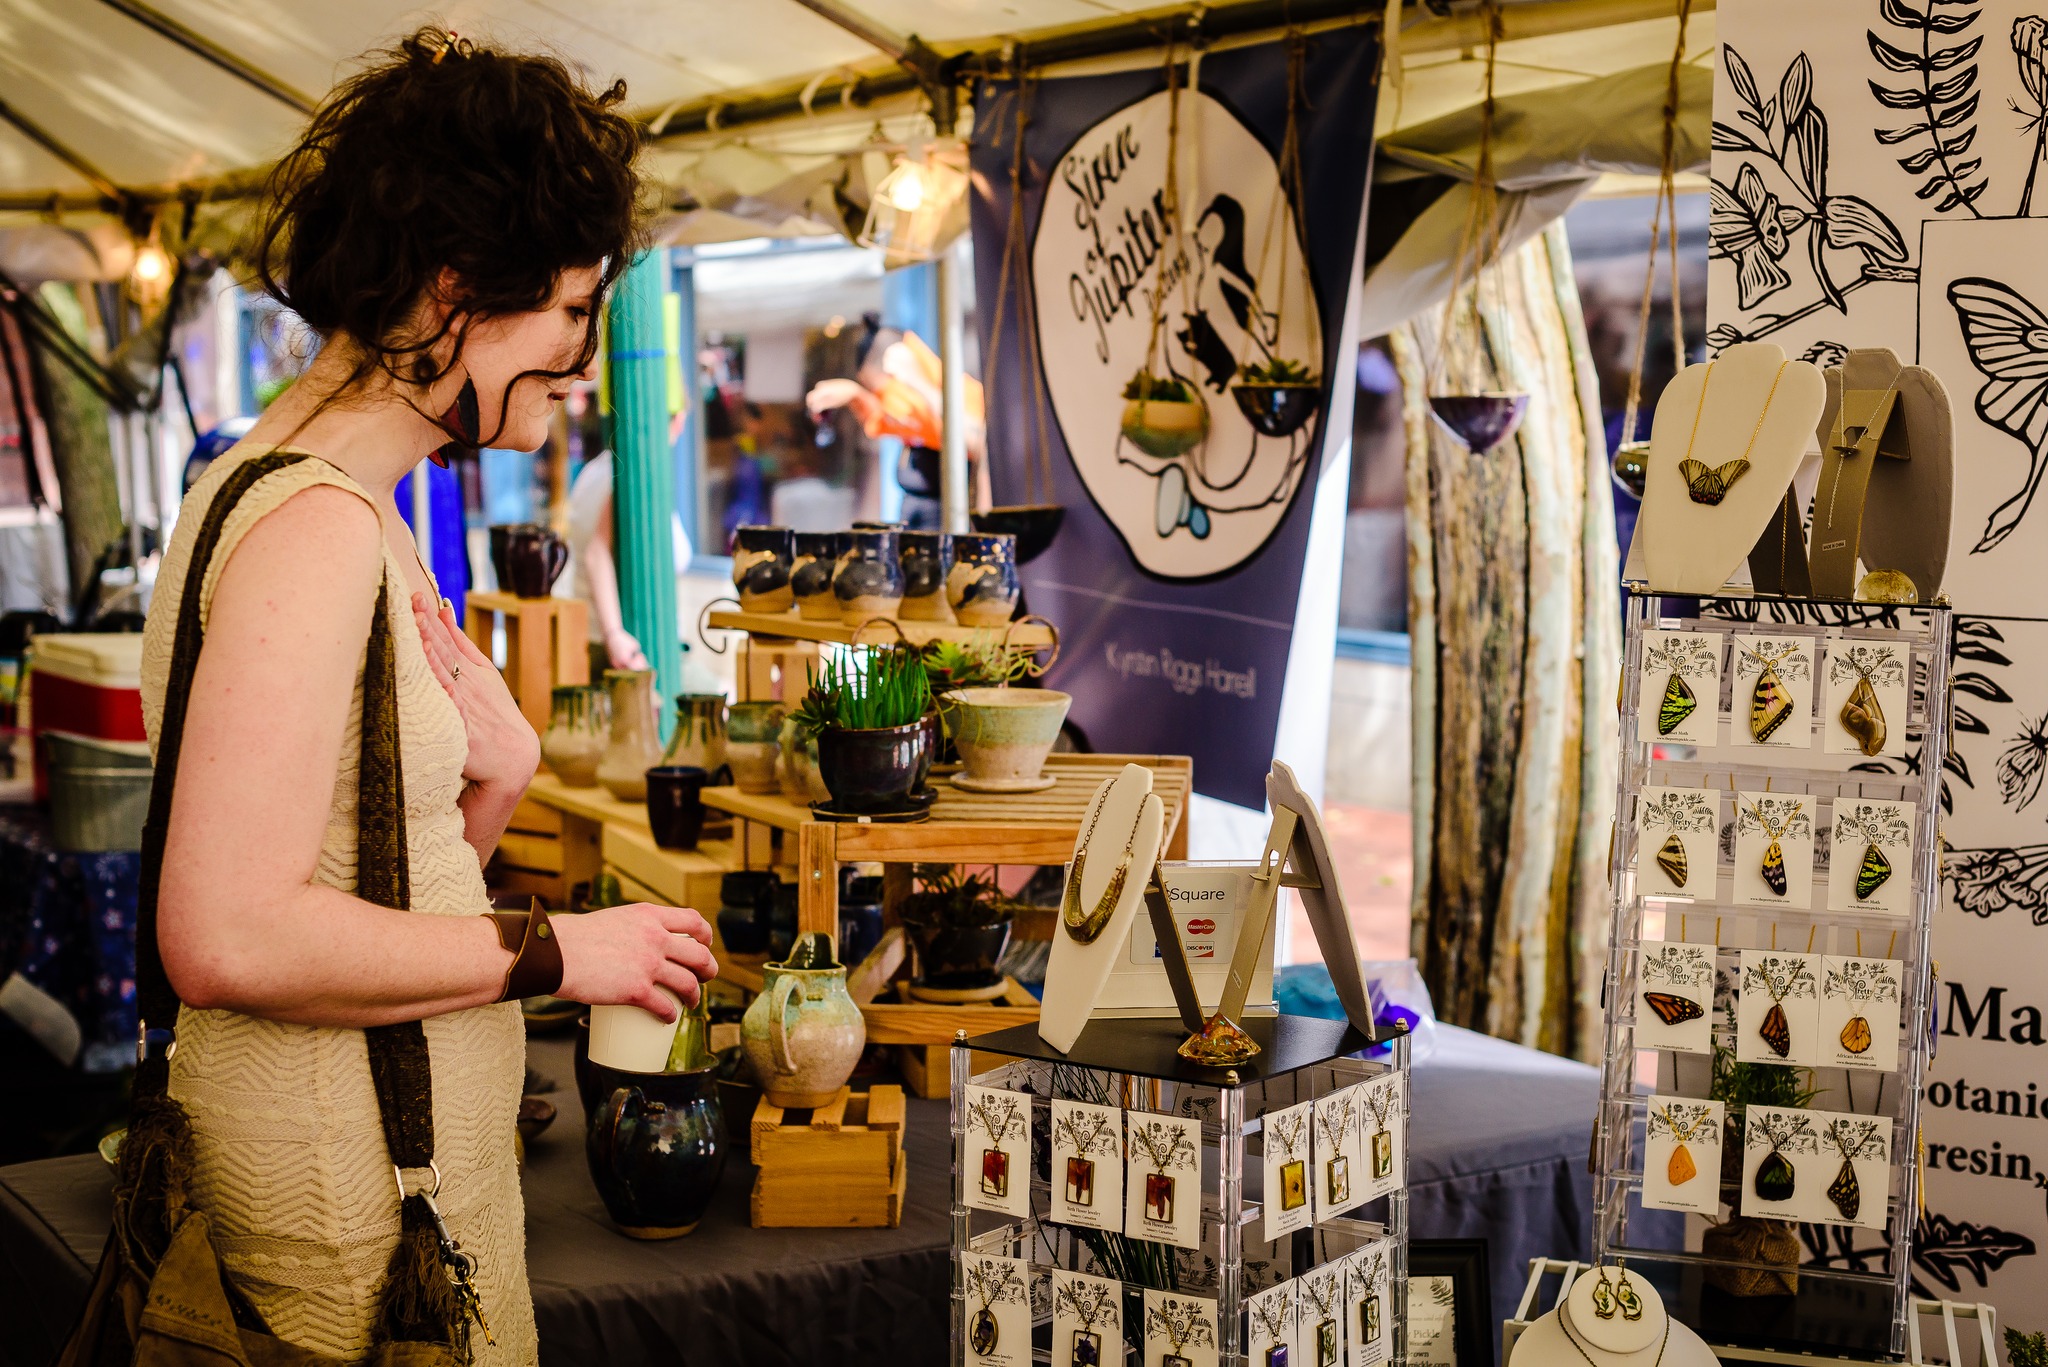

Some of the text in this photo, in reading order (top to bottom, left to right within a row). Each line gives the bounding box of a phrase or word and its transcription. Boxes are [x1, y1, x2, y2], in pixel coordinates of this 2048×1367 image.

[1062, 125, 1140, 230] Siren
[1070, 187, 1174, 364] Jupiter
[1170, 887, 1225, 903] Square
[1941, 981, 2047, 1046] Ma
[1921, 1078, 2048, 1119] otani
[1927, 1141, 2047, 1189] resin,
[1413, 1329, 1440, 1338] Pickle
